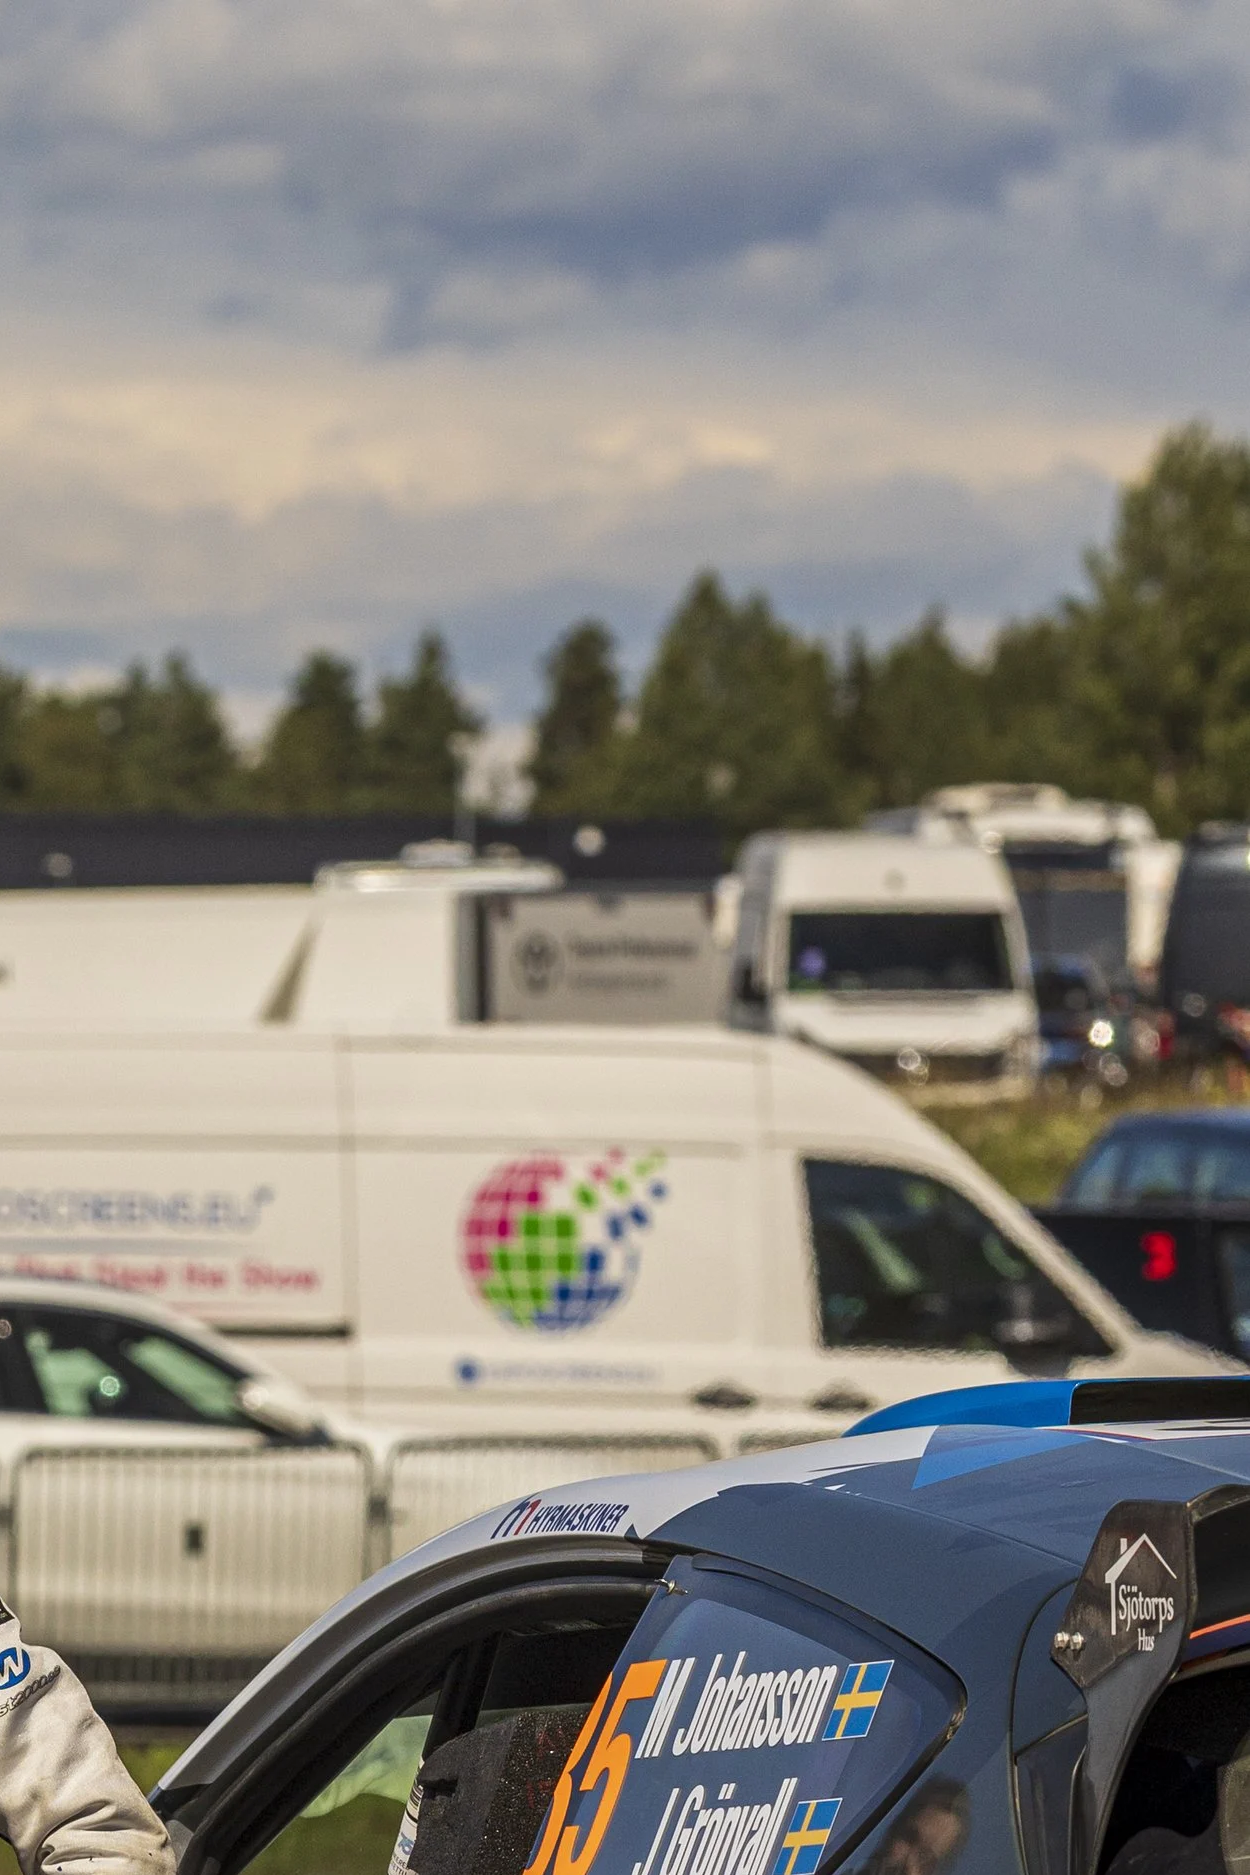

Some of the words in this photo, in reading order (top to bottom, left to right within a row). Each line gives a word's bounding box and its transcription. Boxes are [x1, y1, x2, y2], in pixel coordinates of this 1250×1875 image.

[524, 1503, 630, 1535] HYRMASKINER
[1118, 1584, 1175, 1633] Sjötorps
[1137, 1627, 1155, 1651] Hus
[634, 1657, 696, 1759] M
[672, 1650, 838, 1757] Johansson
